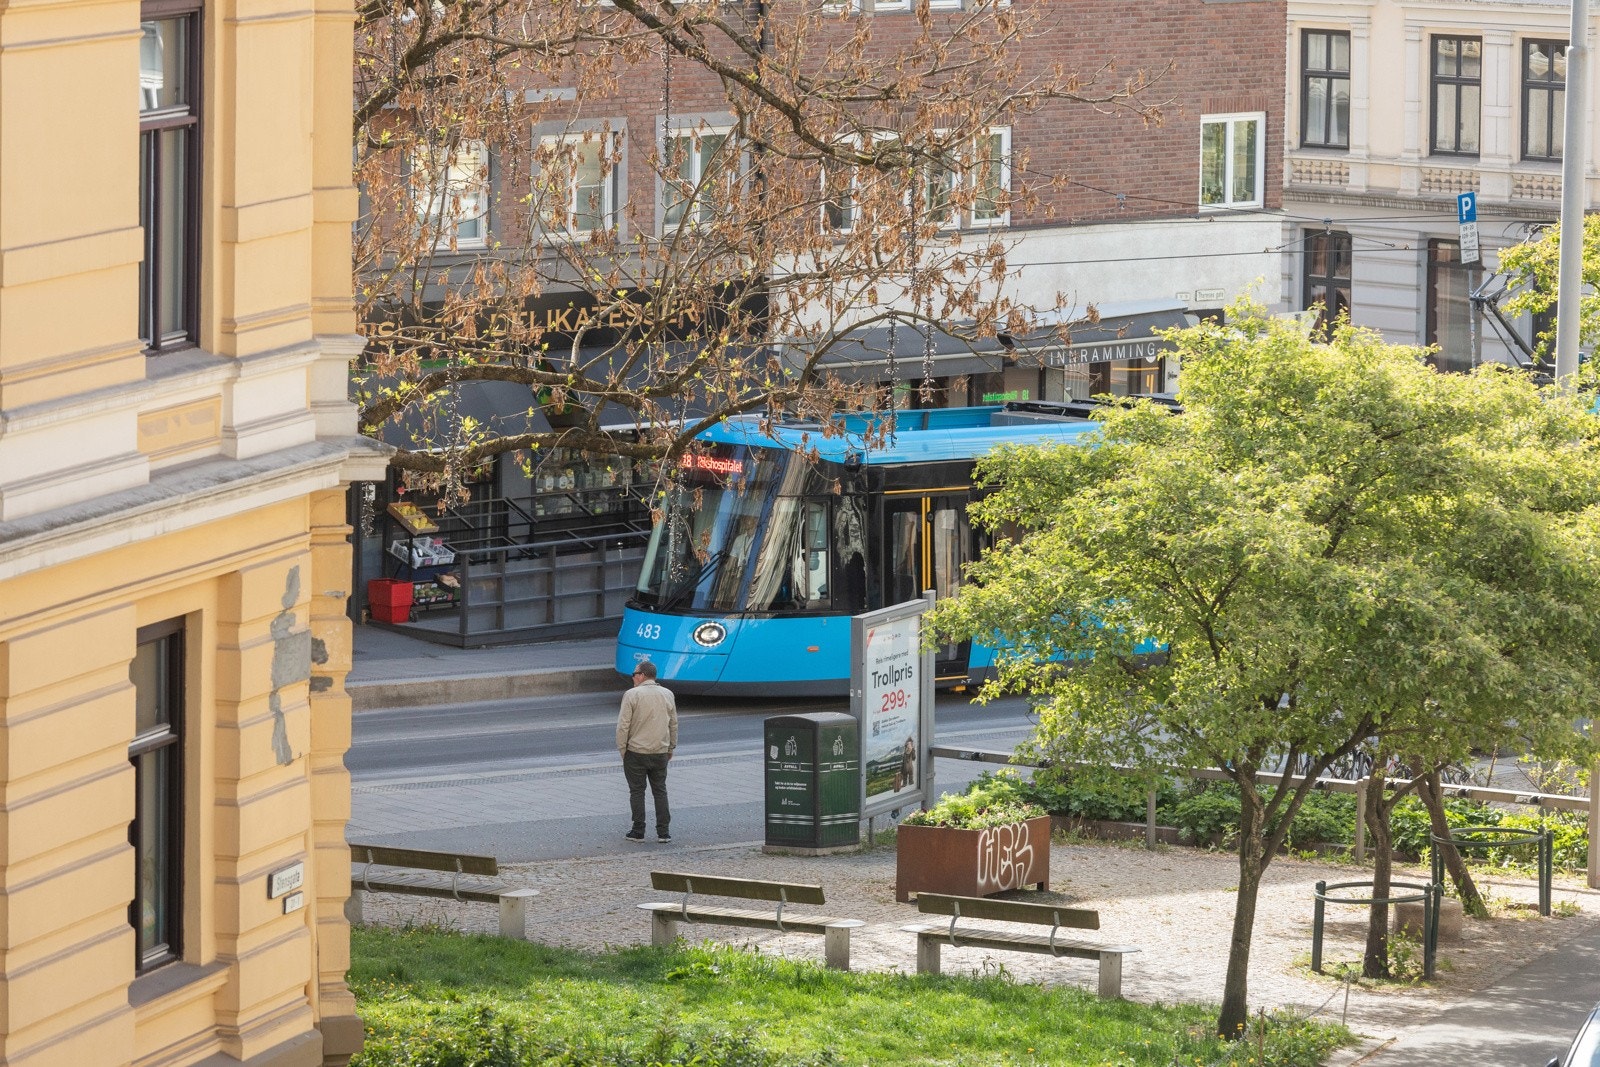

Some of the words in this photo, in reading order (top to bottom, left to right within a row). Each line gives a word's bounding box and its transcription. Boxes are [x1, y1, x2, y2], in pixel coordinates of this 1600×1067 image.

[1461, 196, 1472, 220] P
[1049, 342, 1157, 366] INNRAMMING
[636, 623, 661, 640] 483
[871, 662, 913, 689] Trollpris
[881, 688, 911, 712] 299,-
